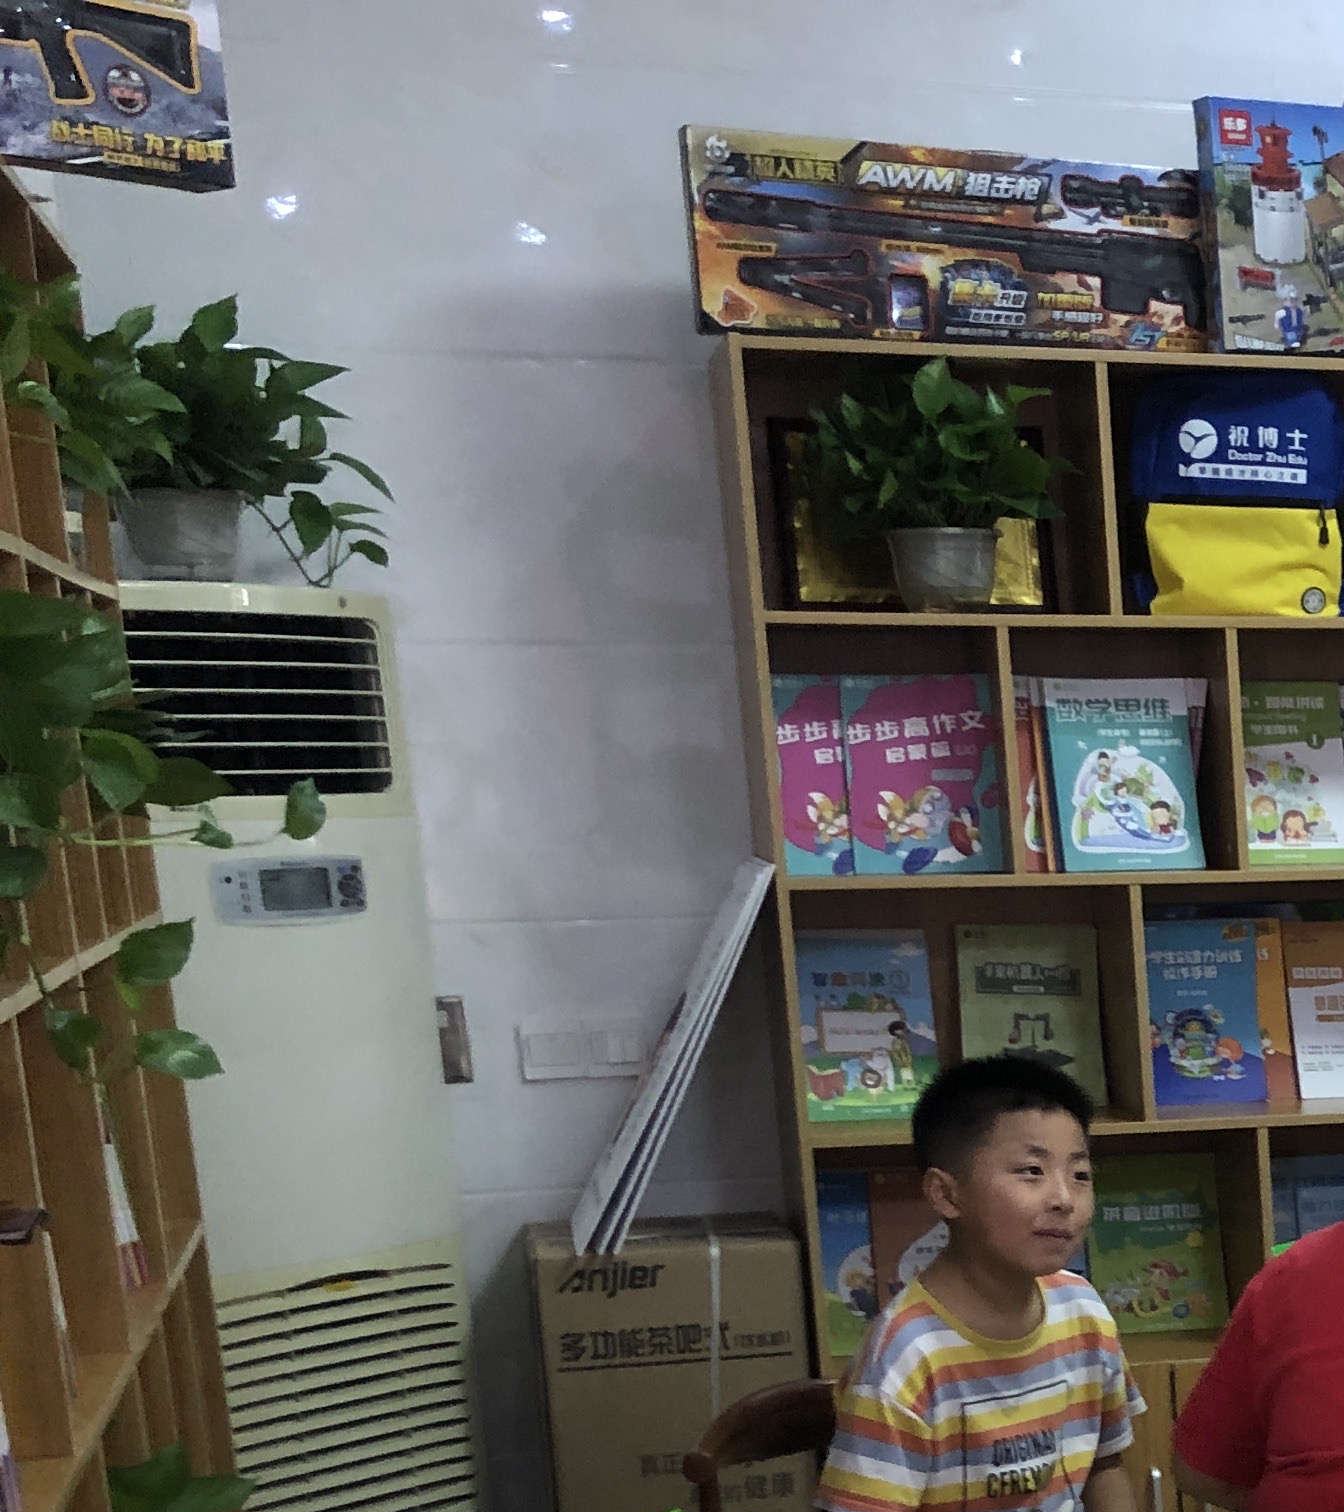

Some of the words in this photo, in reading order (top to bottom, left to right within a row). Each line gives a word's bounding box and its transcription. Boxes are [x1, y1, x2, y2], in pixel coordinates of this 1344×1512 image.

[859, 162, 956, 193] AWM
[964, 171, 1042, 202] 狙击枪
[1228, 424, 1309, 452] 祝博士
[1227, 448, 1263, 463] Doctor
[1264, 450, 1287, 465] Zhu
[1287, 452, 1309, 466] Edu
[1055, 696, 1172, 723] 数学思维
[847, 709, 986, 745] 步步高作文
[885, 741, 952, 764] 启蒙篇
[557, 1261, 665, 1300] Anjier
